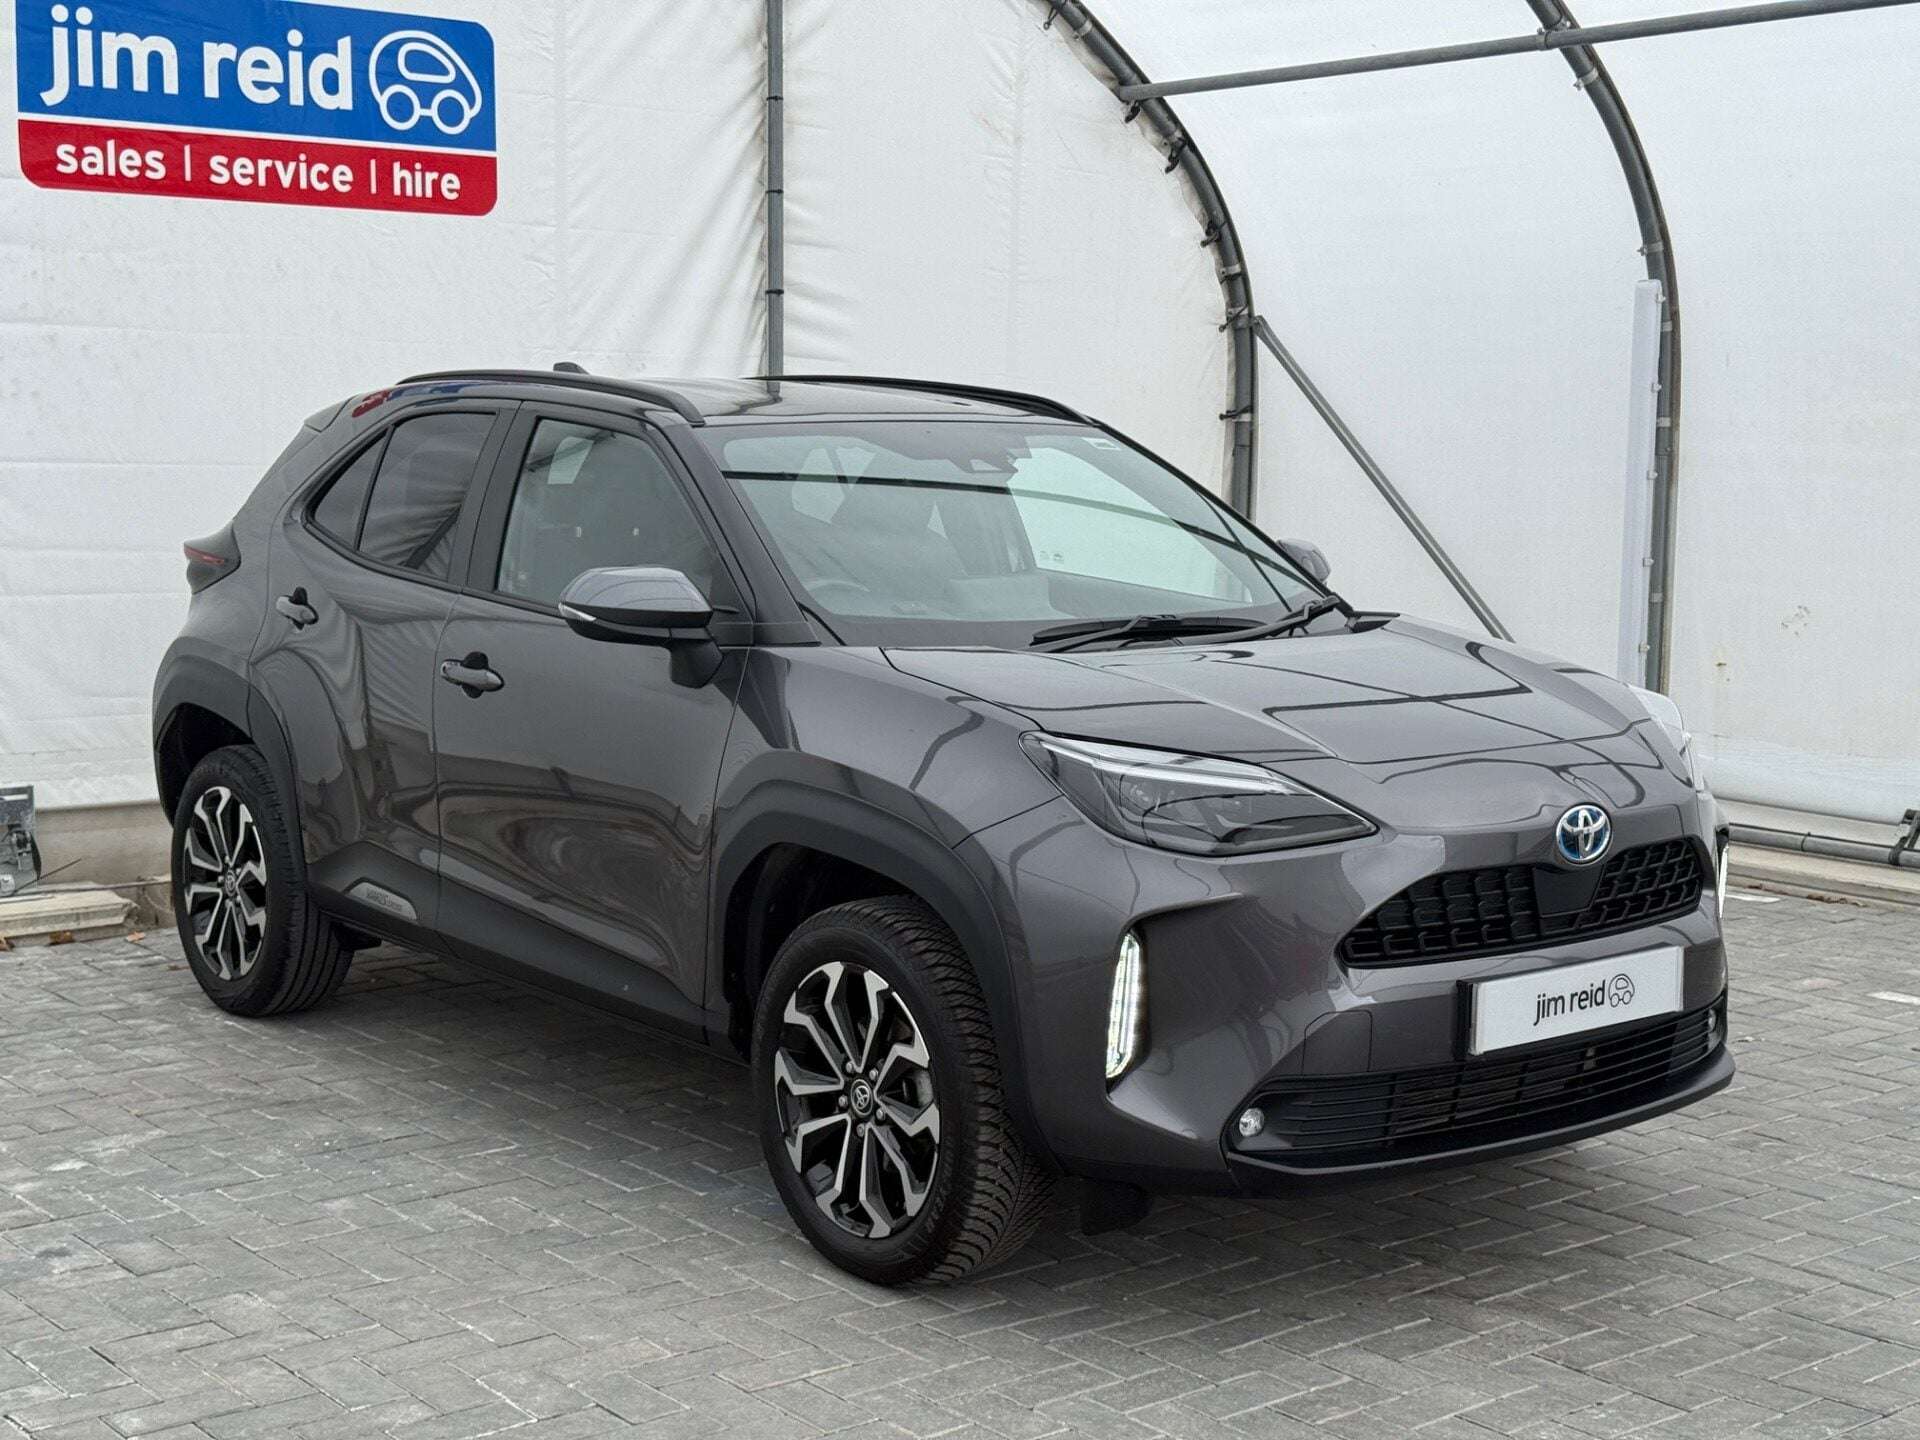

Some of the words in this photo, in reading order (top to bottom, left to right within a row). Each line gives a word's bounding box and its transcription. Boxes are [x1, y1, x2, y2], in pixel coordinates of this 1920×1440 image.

[40, 4, 179, 107] jim
[203, 29, 353, 111] reid
[56, 140, 167, 180] sales
[209, 154, 354, 192] service
[393, 162, 461, 200] hire
[1533, 994, 1565, 1026] jim
[1569, 980, 1606, 1012] reid
